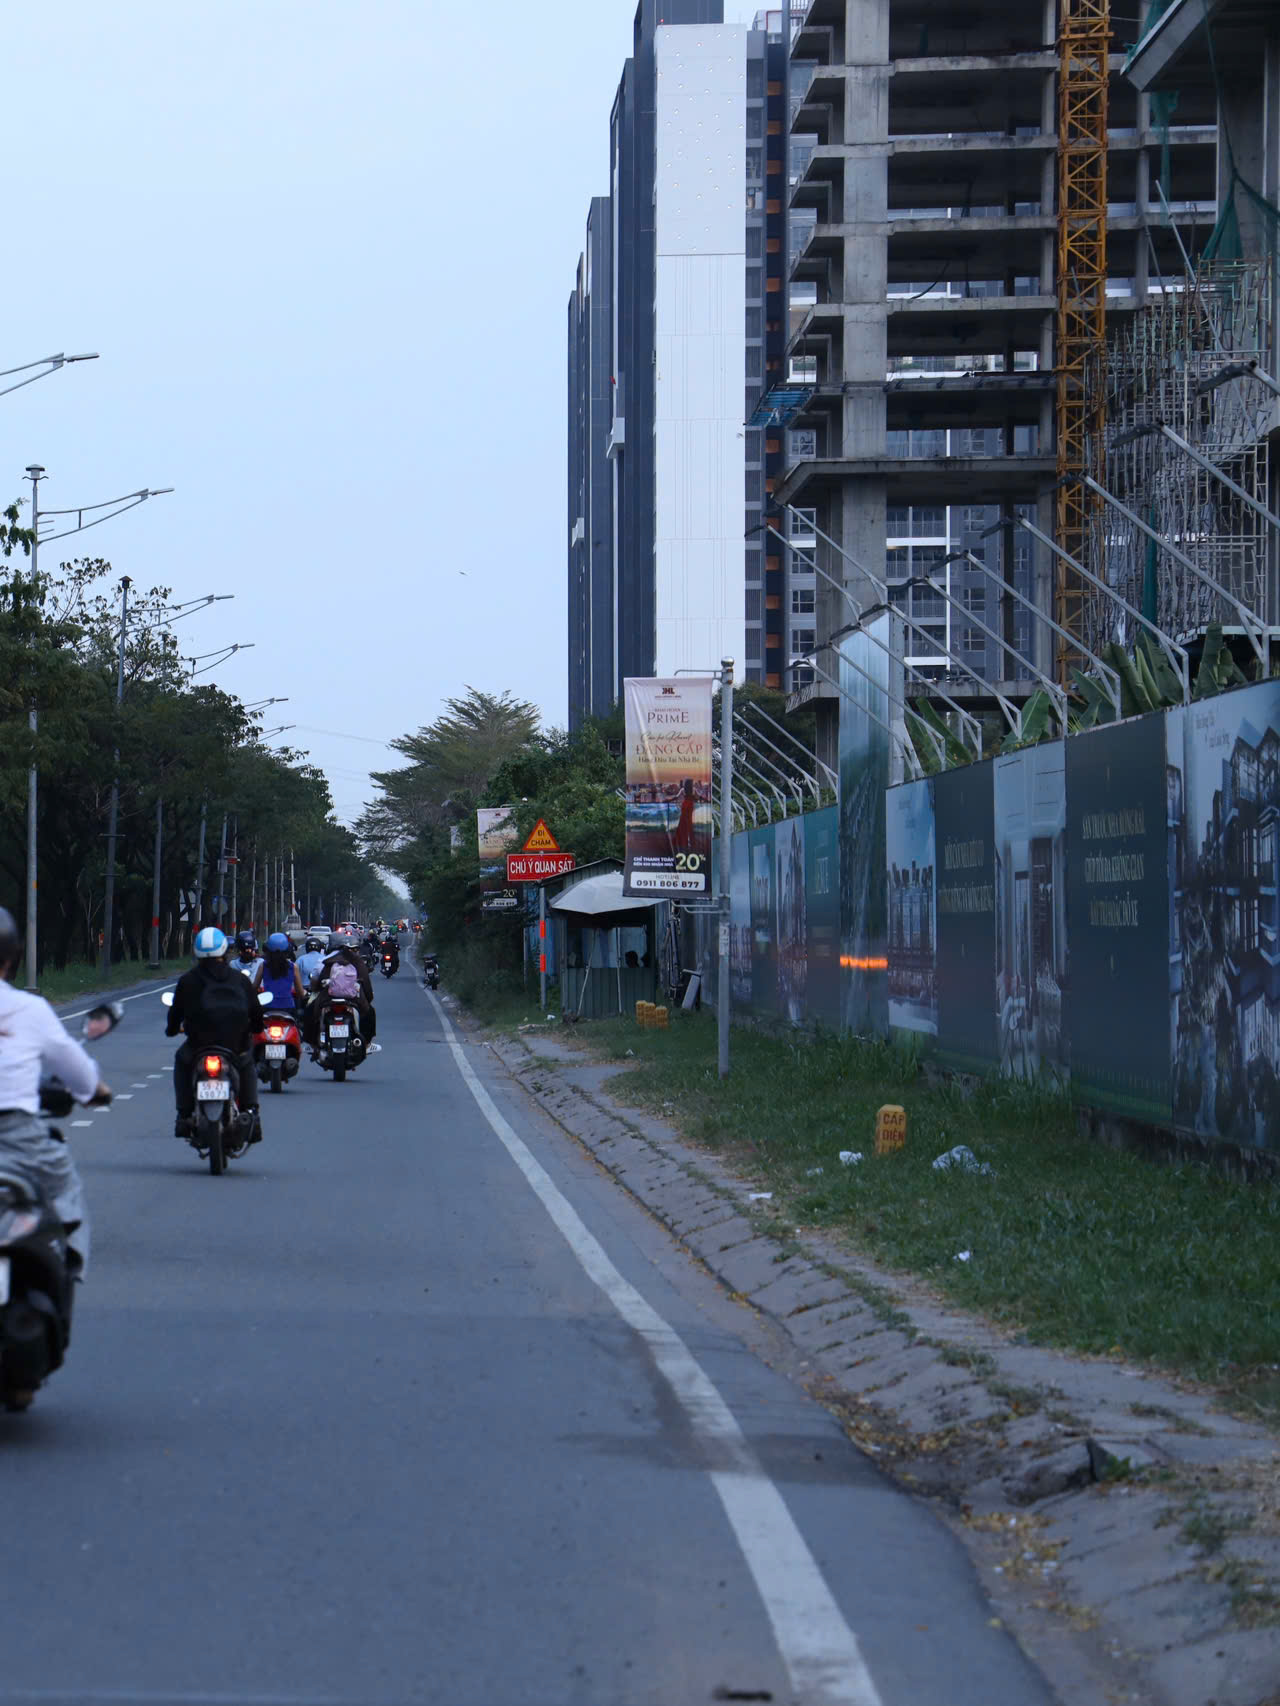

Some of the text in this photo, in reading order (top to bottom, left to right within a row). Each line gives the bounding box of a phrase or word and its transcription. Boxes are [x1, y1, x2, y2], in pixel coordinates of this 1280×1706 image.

[648, 711, 689, 724] PRIME
[536, 829, 545, 837] ĐI
[510, 857, 573, 874] CHÚ Ý QUAN SÁT
[636, 879, 700, 889] 0911 806 877
